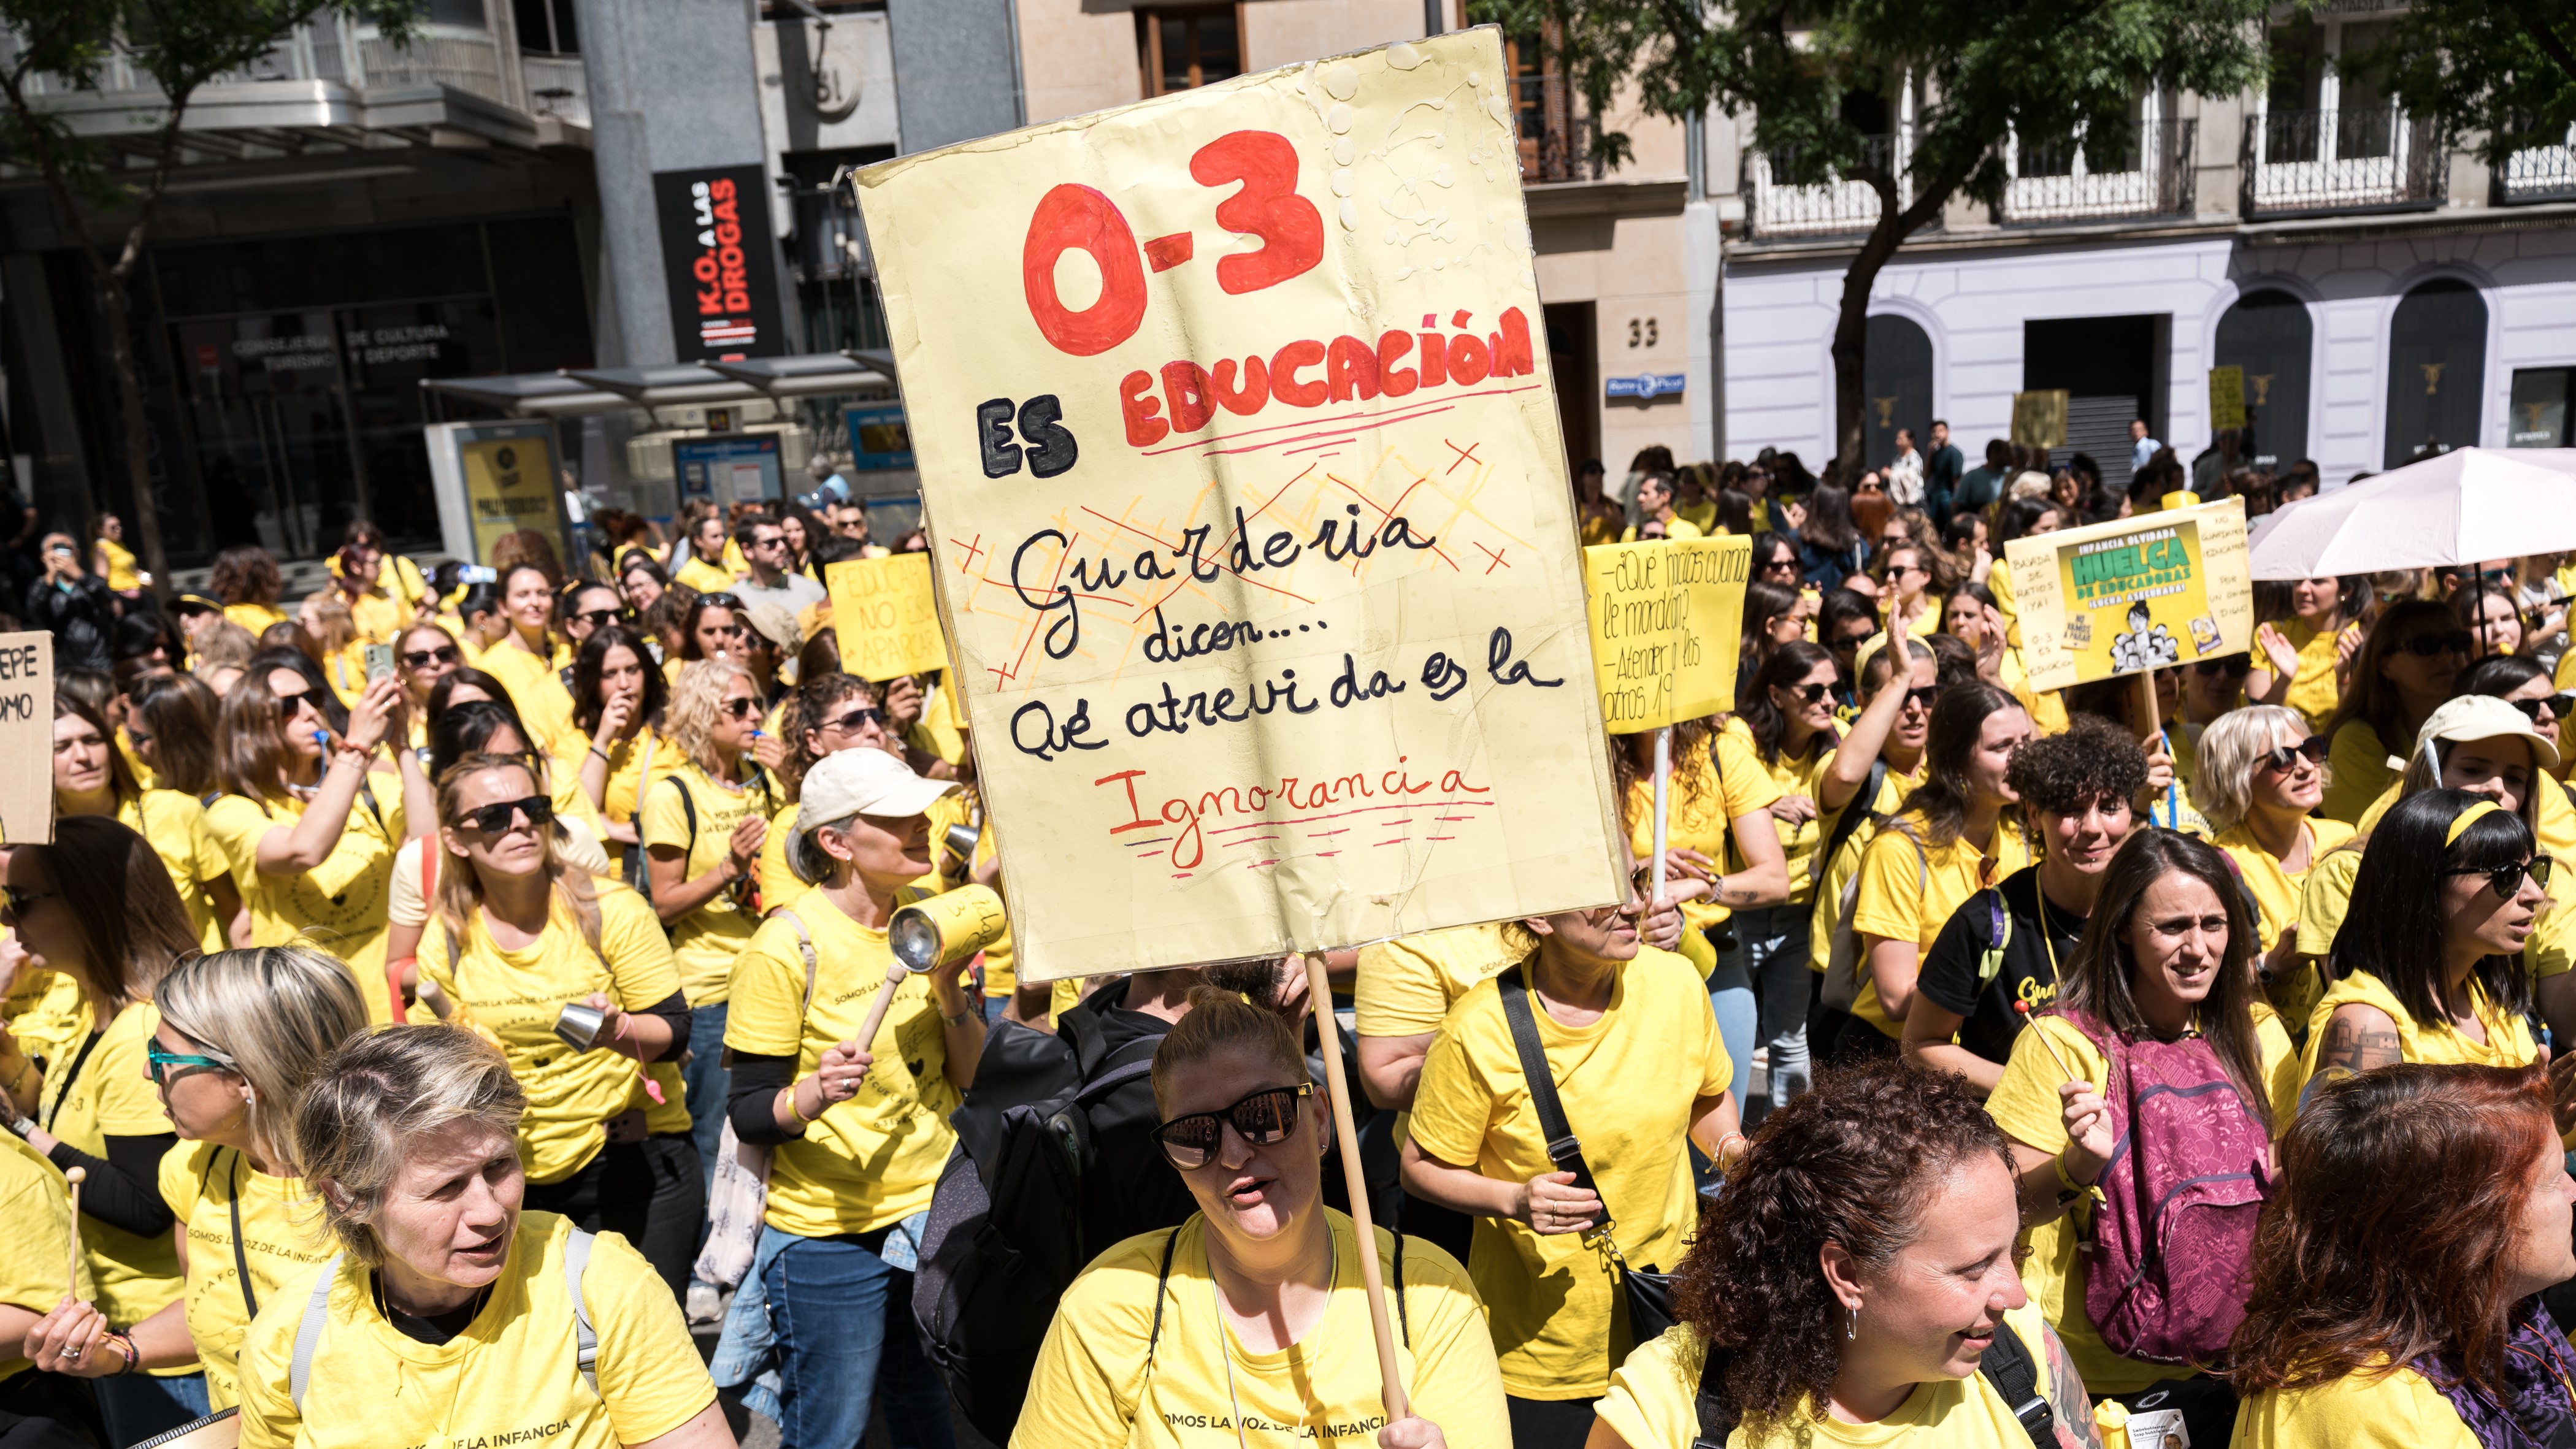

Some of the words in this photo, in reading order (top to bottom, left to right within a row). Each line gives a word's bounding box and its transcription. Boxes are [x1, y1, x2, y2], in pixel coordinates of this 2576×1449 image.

[691, 182, 713, 226] LAS
[698, 229, 716, 247] A
[710, 178, 751, 313] DROGAS
[1023, 129, 1324, 356] 0-3
[694, 247, 724, 315] K.O.
[1629, 319, 1657, 348] 33
[977, 394, 1078, 479] ES
[2079, 538, 2125, 556] INFANCIA
[2127, 527, 2177, 546] OLVIDADA
[1665, 546, 1703, 587] hacías
[2071, 537, 2190, 586] HUELGA
[1011, 504, 1437, 659] Guarderia
[2016, 581, 2053, 599] RATIOS
[2077, 586, 2094, 600] DE
[2099, 567, 2191, 595] EDUCADORAS
[859, 601, 897, 630] NO
[905, 595, 926, 625] ES
[1604, 592, 1619, 639] le
[1684, 628, 1700, 667] los
[2032, 632, 2053, 644] 0-3
[1421, 651, 1467, 702] es
[1488, 625, 1565, 688] la
[1603, 684, 1646, 722] otros
[1095, 755, 1490, 870] Ignorancia
[835, 987, 867, 1005] SOMOS
[868, 982, 880, 991] LA
[188, 1228, 223, 1244] SOMOS
[259, 1242, 275, 1255] DE
[277, 1247, 291, 1257] LA
[493, 1419, 572, 1447] INFANCIA
[1211, 1417, 1232, 1429] LA
[1300, 1424, 1318, 1439] LA
[1322, 1416, 1388, 1439] INFANCI
